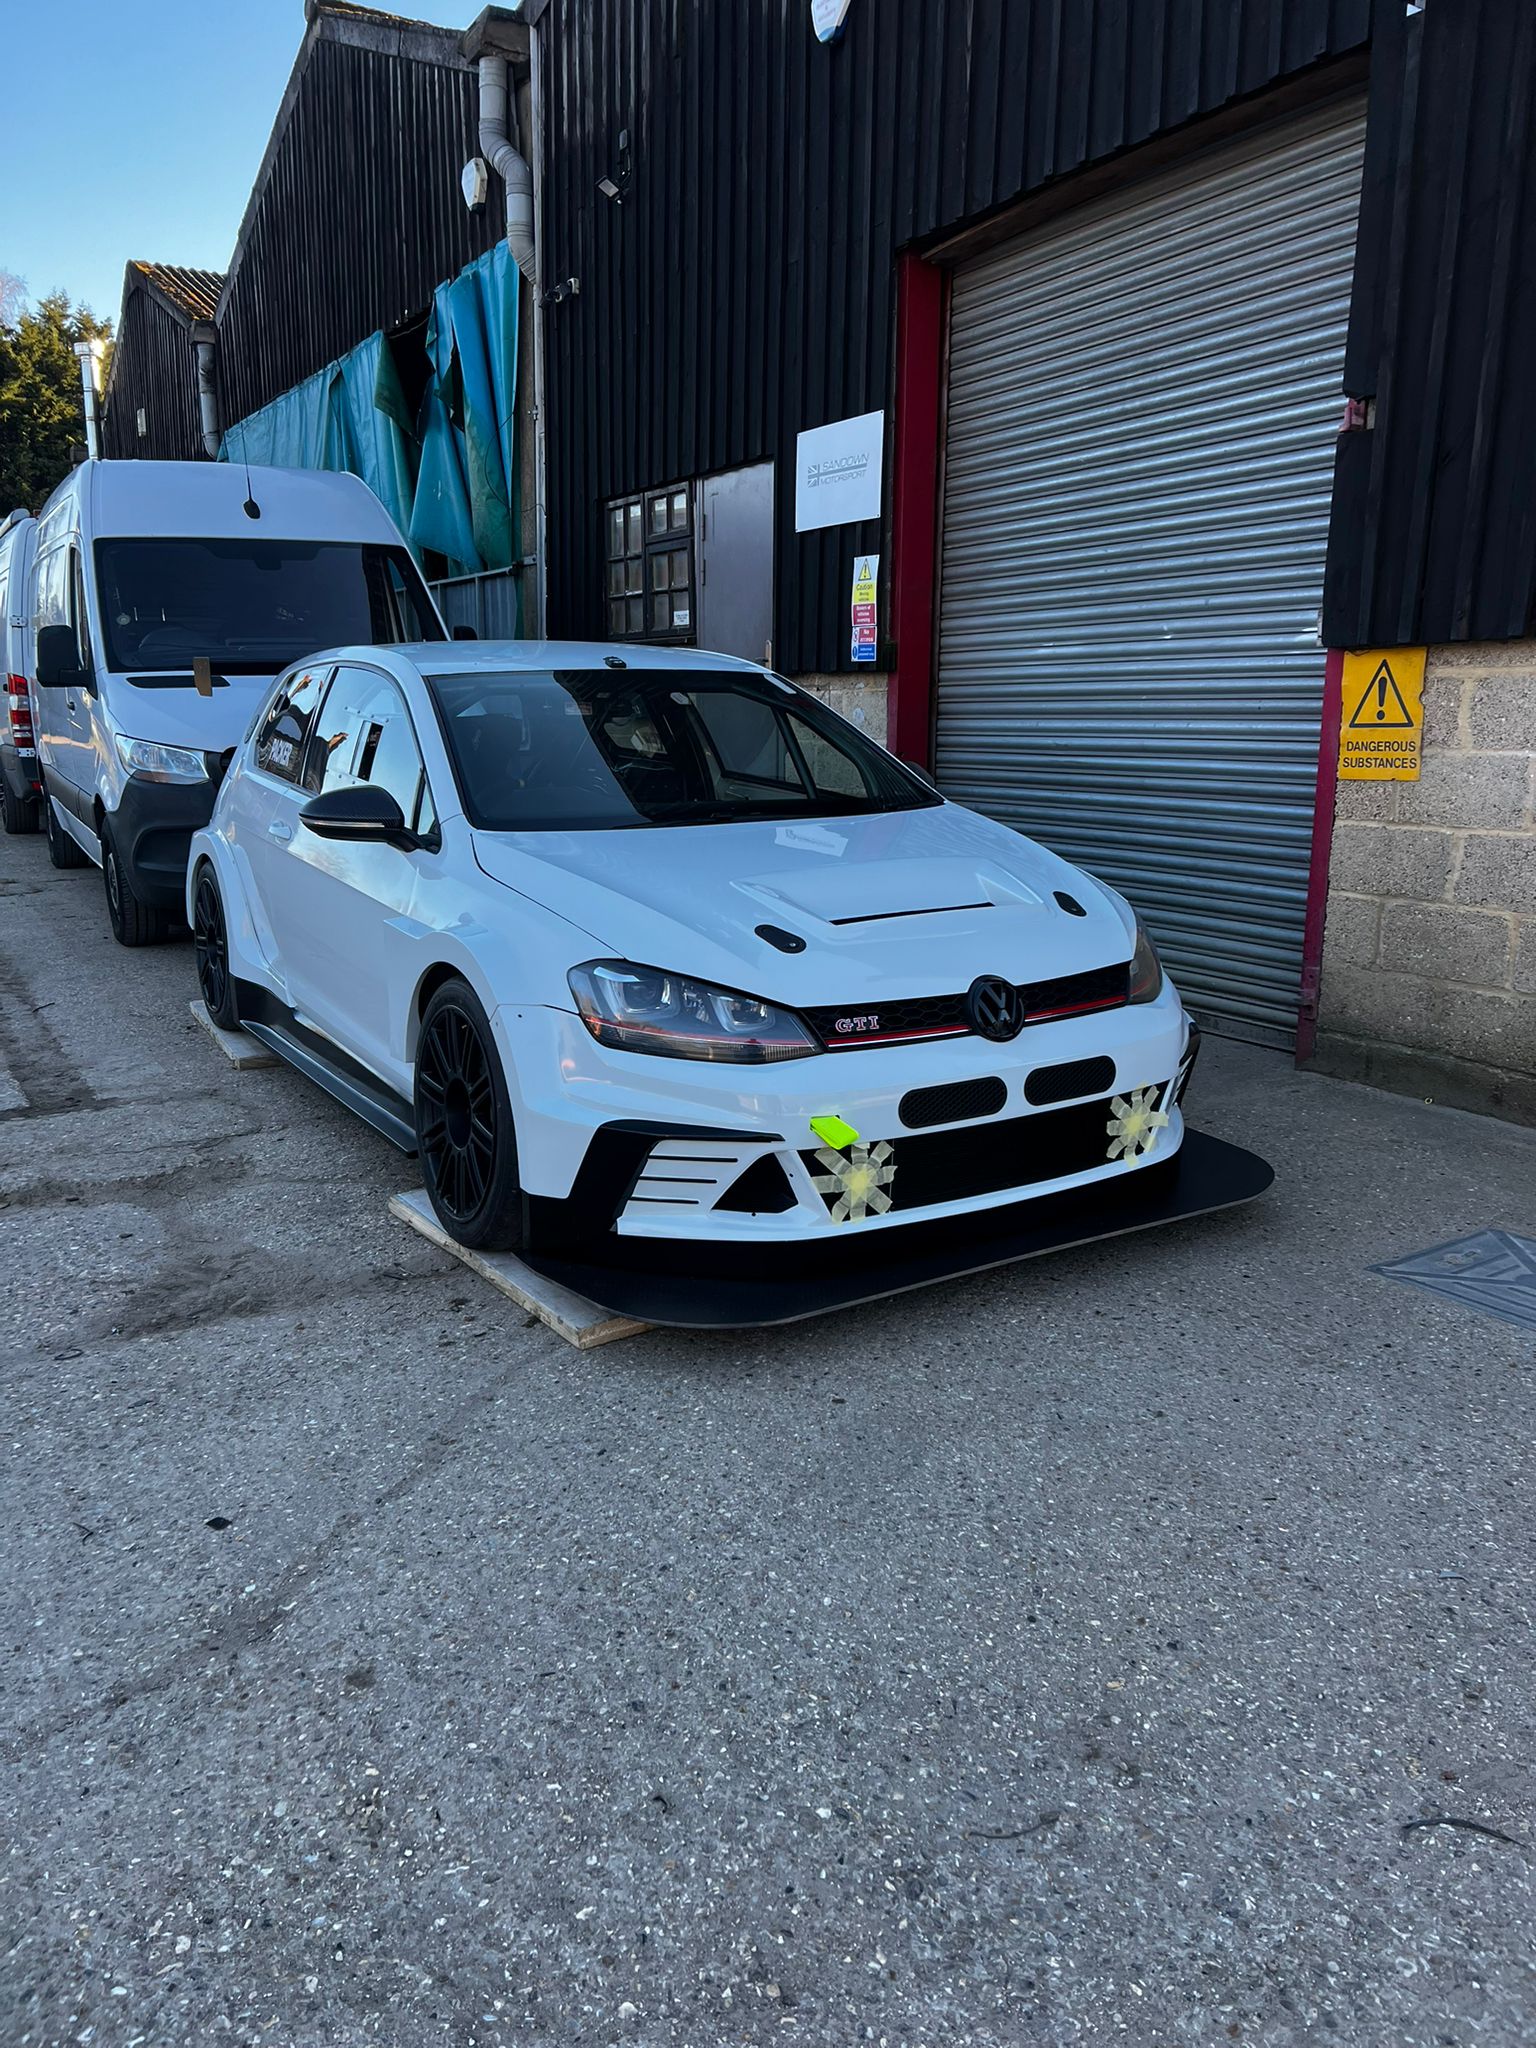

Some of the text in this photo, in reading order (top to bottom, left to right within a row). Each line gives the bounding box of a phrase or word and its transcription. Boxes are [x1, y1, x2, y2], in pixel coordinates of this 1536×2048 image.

[823, 452, 870, 471] SANDOWN
[1346, 741, 1416, 752] DANGEROUS
[1342, 757, 1417, 768] SUBSTANCES
[835, 1015, 880, 1033] GTI
